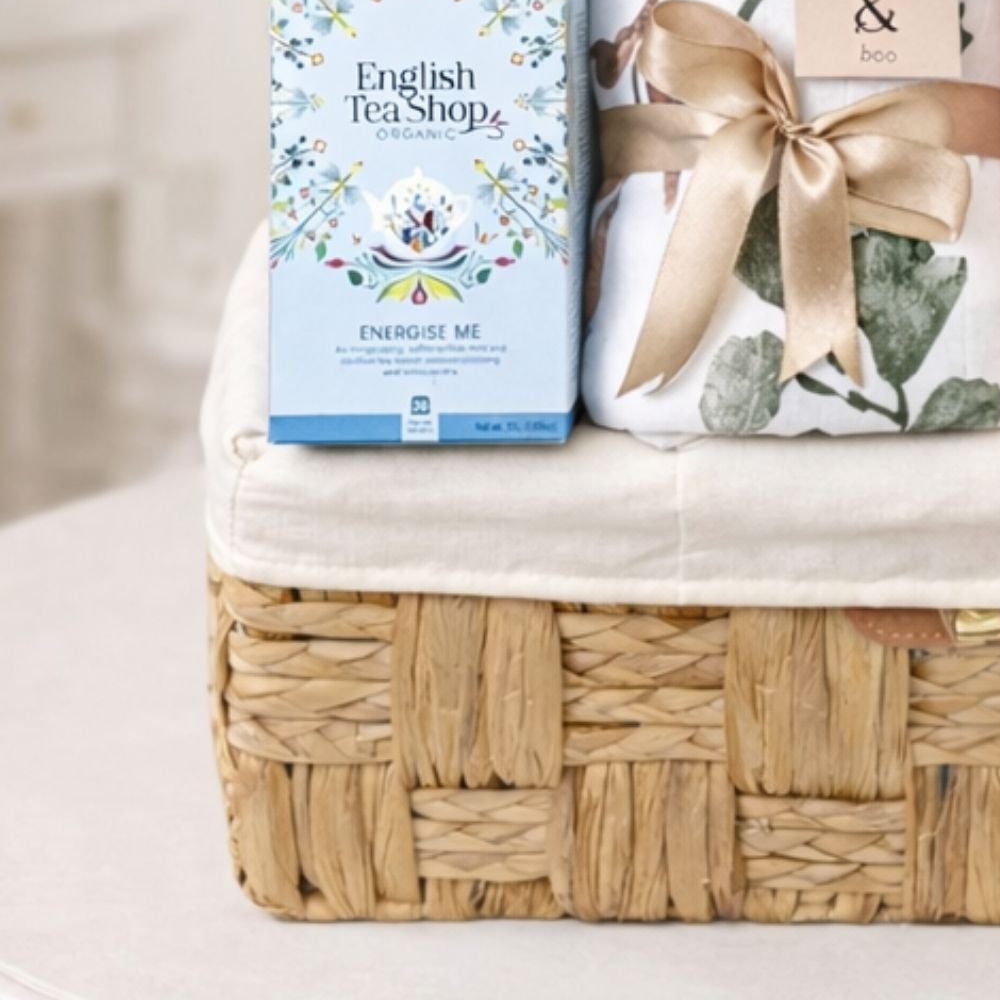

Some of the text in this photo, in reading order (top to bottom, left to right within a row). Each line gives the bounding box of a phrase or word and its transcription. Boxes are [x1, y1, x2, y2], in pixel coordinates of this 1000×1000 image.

[859, 42, 898, 63] boo
[356, 60, 476, 100] English
[344, 94, 492, 133] Tea Shop
[375, 126, 457, 141] ORGANIC
[359, 322, 482, 342] ENERGISE ME
